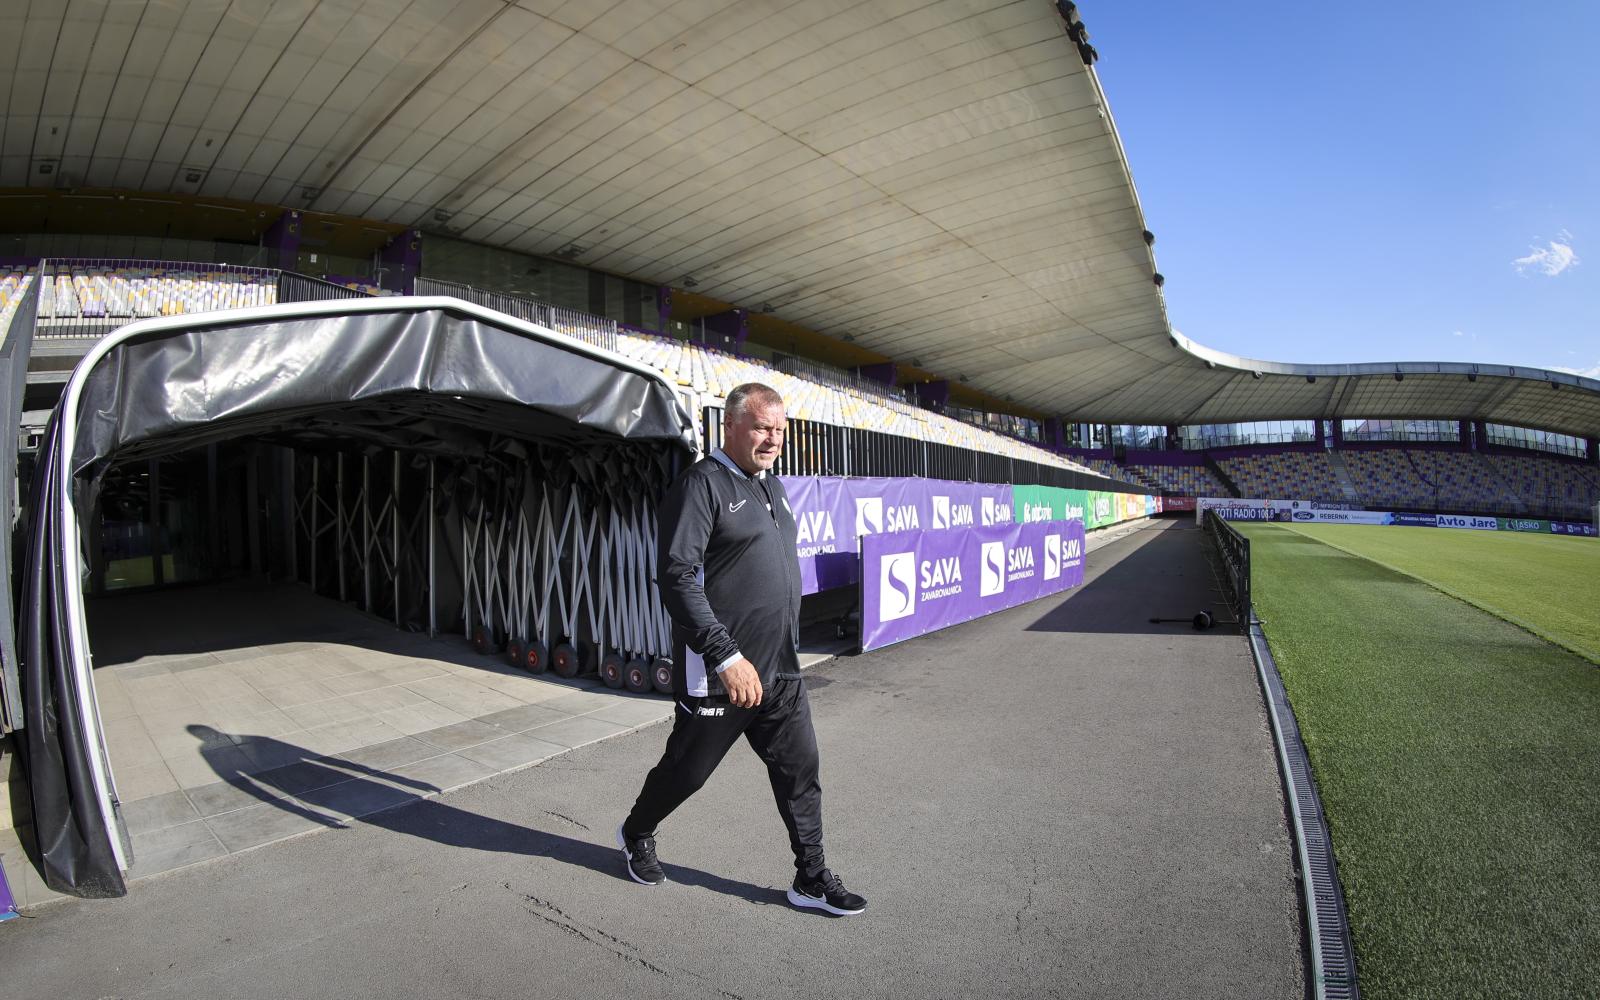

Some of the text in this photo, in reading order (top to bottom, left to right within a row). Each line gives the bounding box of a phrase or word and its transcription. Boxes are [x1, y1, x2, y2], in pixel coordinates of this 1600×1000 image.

[887, 505, 919, 533] SAVA
[952, 504, 973, 526] SAVA
[995, 504, 1011, 522] SAVA
[1233, 508, 1256, 519] RADIO
[1438, 516, 1466, 527] Avto
[1470, 517, 1497, 528] Jarc
[793, 511, 835, 543] AVA
[1008, 545, 1035, 573] SAVA
[1062, 539, 1081, 561] SAVA
[921, 556, 962, 589] SAVA
[921, 584, 963, 603] ZAVAROVALNICA
